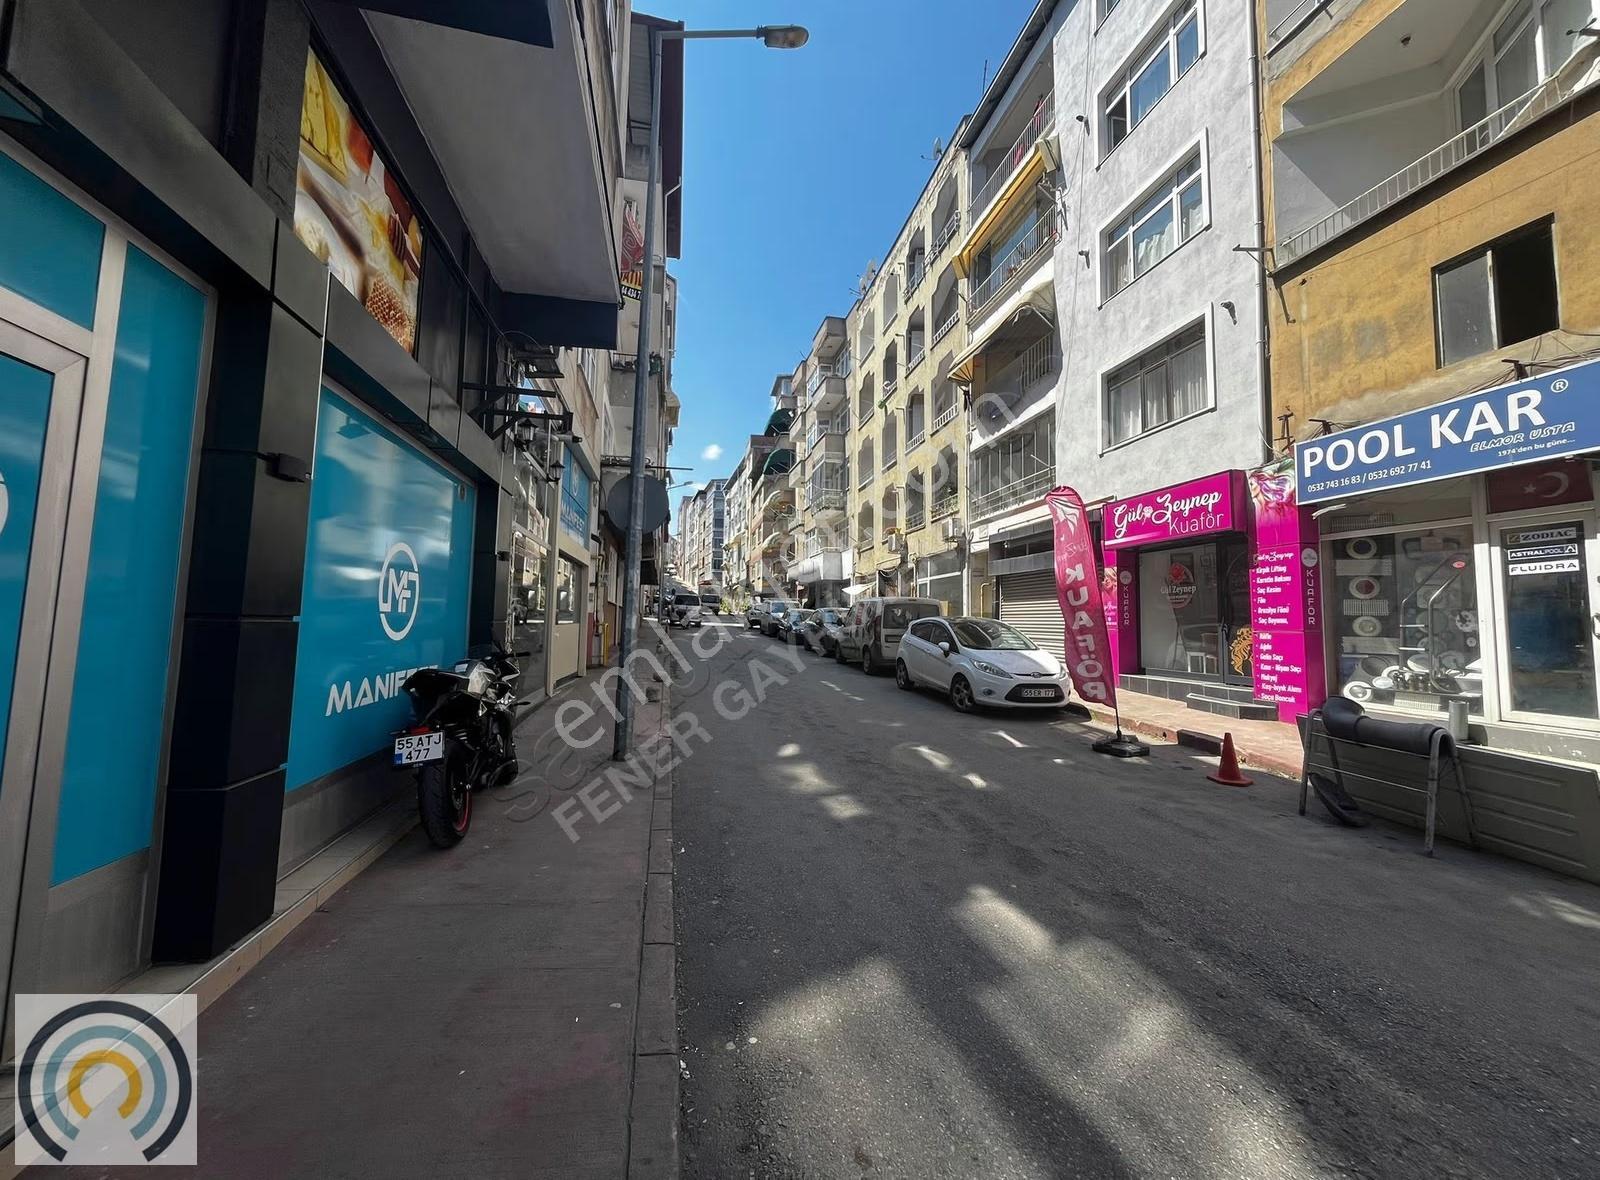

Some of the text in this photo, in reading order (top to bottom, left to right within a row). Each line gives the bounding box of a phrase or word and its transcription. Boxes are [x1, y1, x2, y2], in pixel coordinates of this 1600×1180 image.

[1304, 424, 1415, 477] POOL
[1431, 389, 1545, 449] KAR
[1470, 421, 1575, 452] ELMOR USTA
[1498, 444, 1533, 457] 1974'den
[1534, 442, 1545, 450] bu
[1308, 484, 1324, 493] 0532
[1326, 480, 1339, 489] 743
[1341, 478, 1350, 486] 16
[1351, 475, 1360, 484] 83
[1368, 469, 1388, 480] 0532
[1390, 465, 1405, 476] 692
[1408, 462, 1418, 472] 77
[1420, 460, 1431, 469] 41
[1113, 492, 1223, 539] Gül Zeynep
[1169, 511, 1224, 535] Kuaför
[1521, 529, 1573, 541] ZODIAC
[1511, 562, 1577, 572] FLUIDRA
[325, 664, 439, 717] MANIF
[397, 733, 441, 750] 55 ATJ
[405, 748, 430, 761] 477
